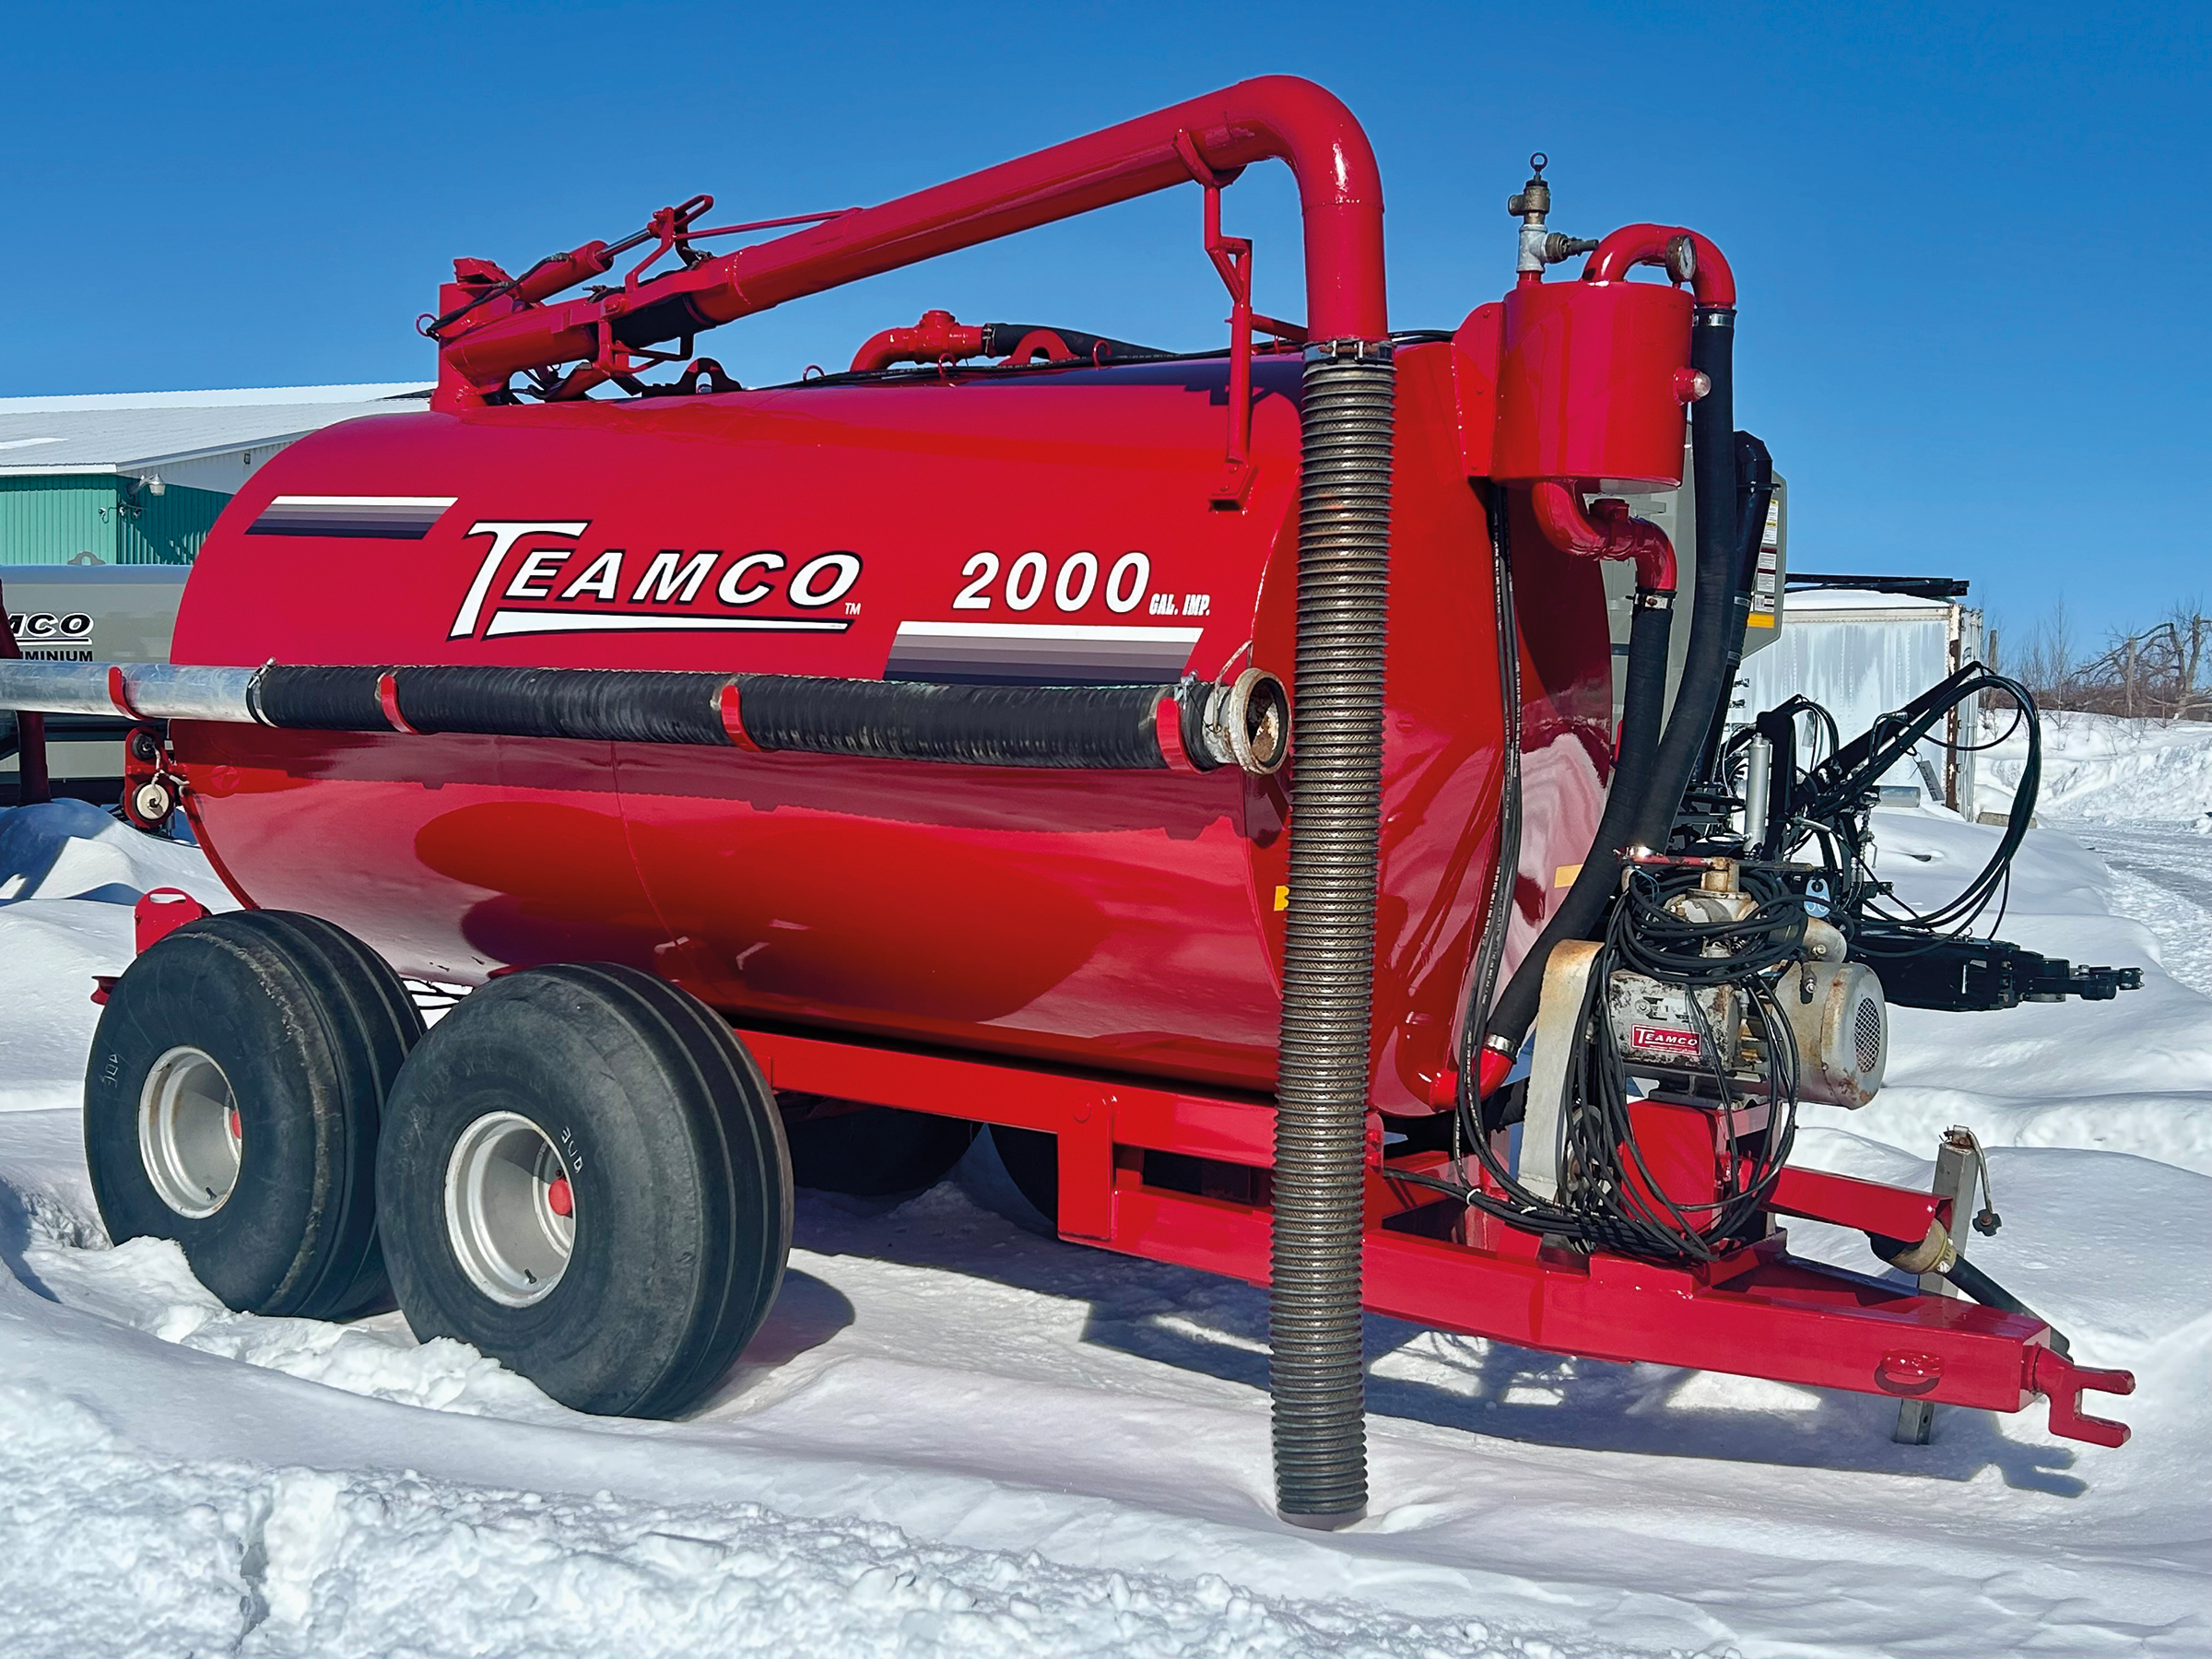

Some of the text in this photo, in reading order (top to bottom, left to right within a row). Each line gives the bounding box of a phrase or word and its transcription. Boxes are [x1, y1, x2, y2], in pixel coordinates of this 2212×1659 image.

[446, 520, 864, 641] TEAMCO
[952, 550, 1211, 616] 2000 GAL. IMP.
[20, 650, 94, 663] MINIUM
[1635, 1028, 1698, 1047] TEAMCO
